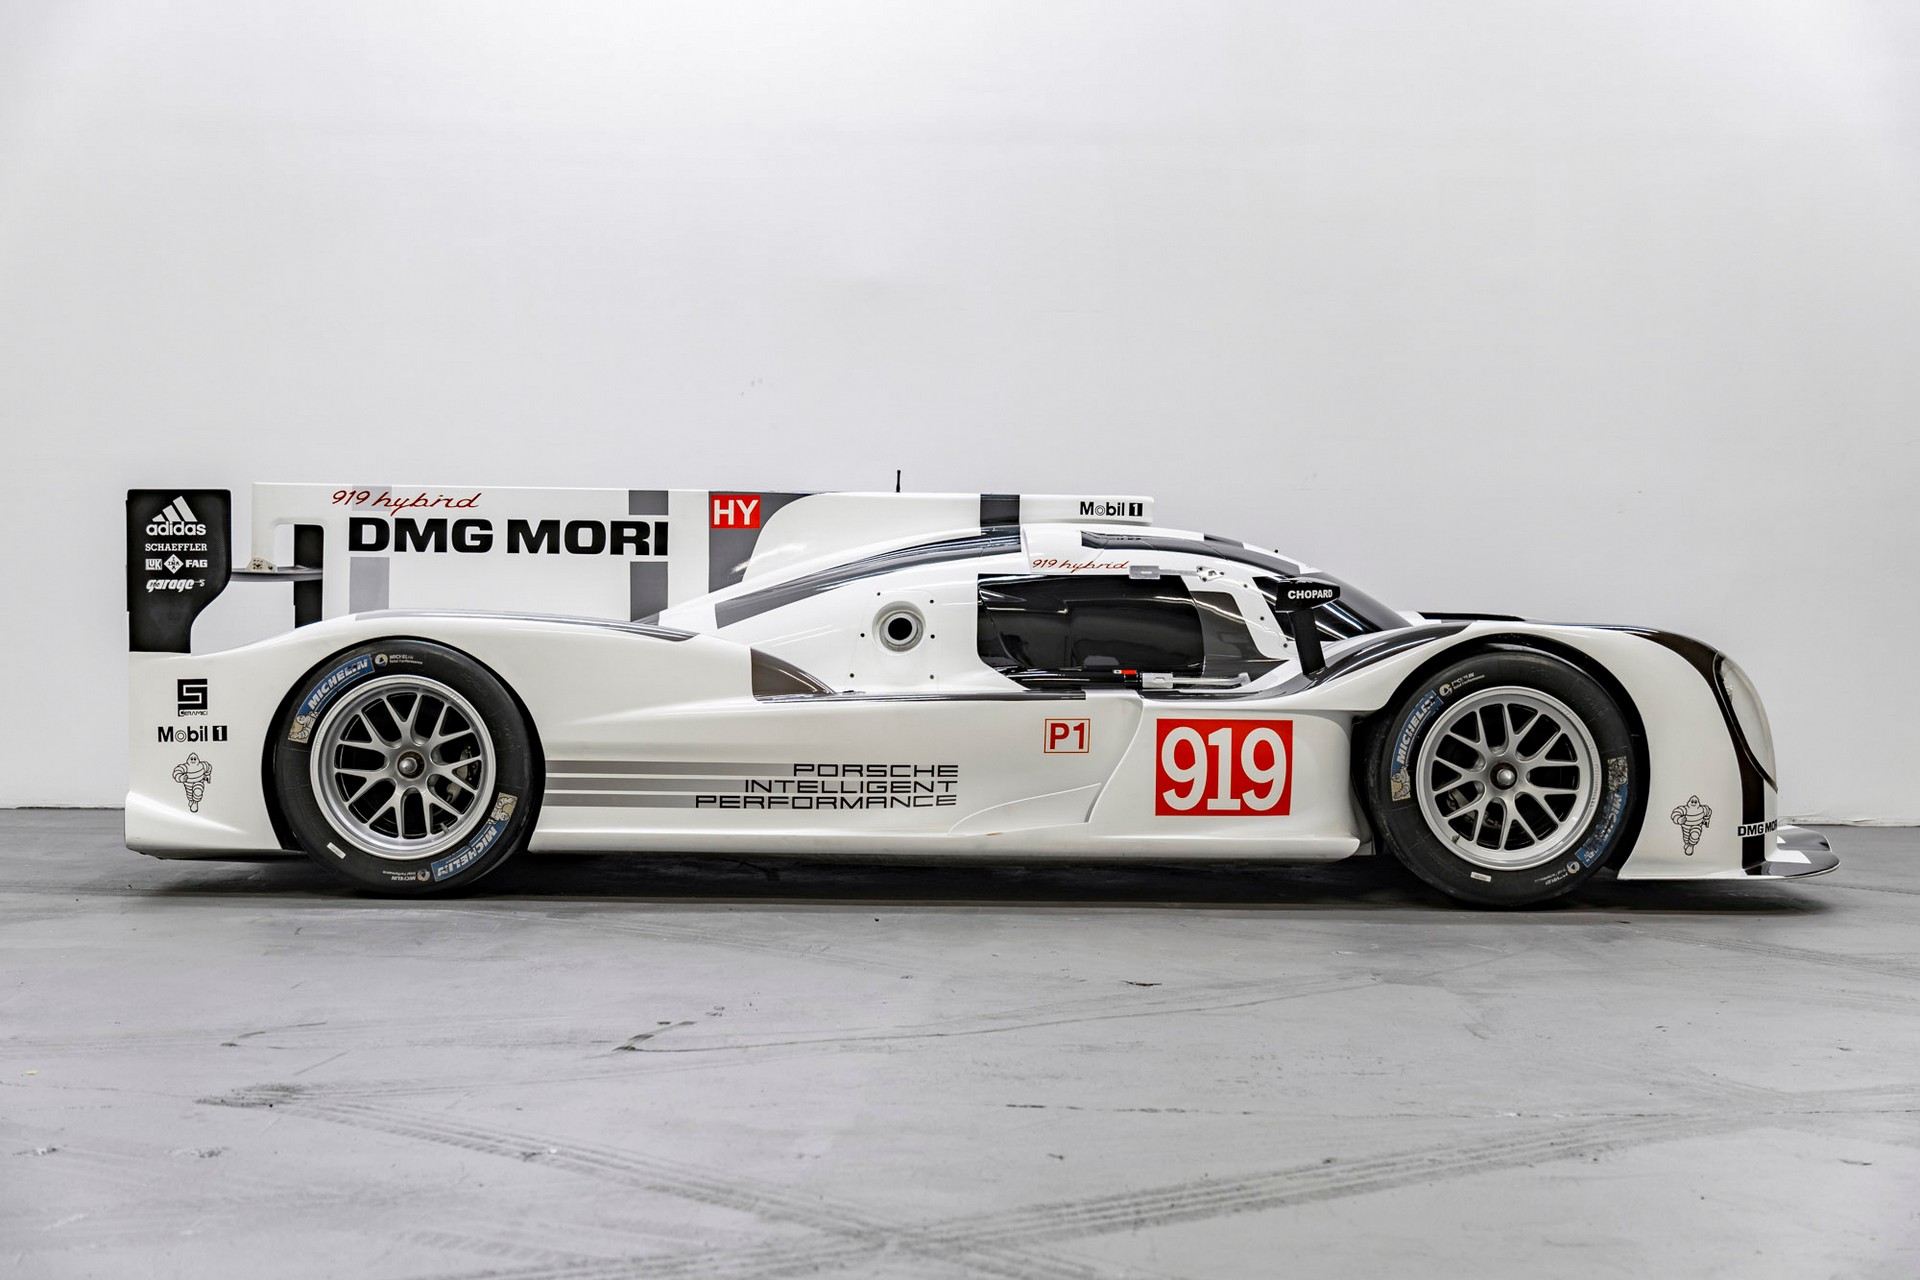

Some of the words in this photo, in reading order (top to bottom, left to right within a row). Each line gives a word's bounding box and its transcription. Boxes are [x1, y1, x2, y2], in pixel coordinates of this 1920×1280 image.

[332, 490, 370, 505] 919
[371, 491, 482, 516] hybrid
[1080, 501, 1125, 516] Mobil
[713, 499, 759, 525] HY
[146, 520, 207, 536] adidas
[349, 517, 493, 553] DMG
[507, 519, 668, 556] MORI
[145, 543, 208, 551] SCHAEFFLER
[185, 559, 208, 568] FAG
[1032, 559, 1058, 569] 919
[1059, 560, 1130, 573] hybrid
[1287, 589, 1333, 599] CHOPARD
[158, 726, 208, 742] Mobil
[1050, 722, 1085, 750] P1
[793, 763, 959, 778] PORSCHE
[1161, 726, 1287, 811] 919
[745, 779, 958, 794] INTELLIGENT
[696, 795, 957, 809] PERFORMANCE
[1737, 823, 1764, 837] DMG
[437, 826, 498, 877] MICHELIN
